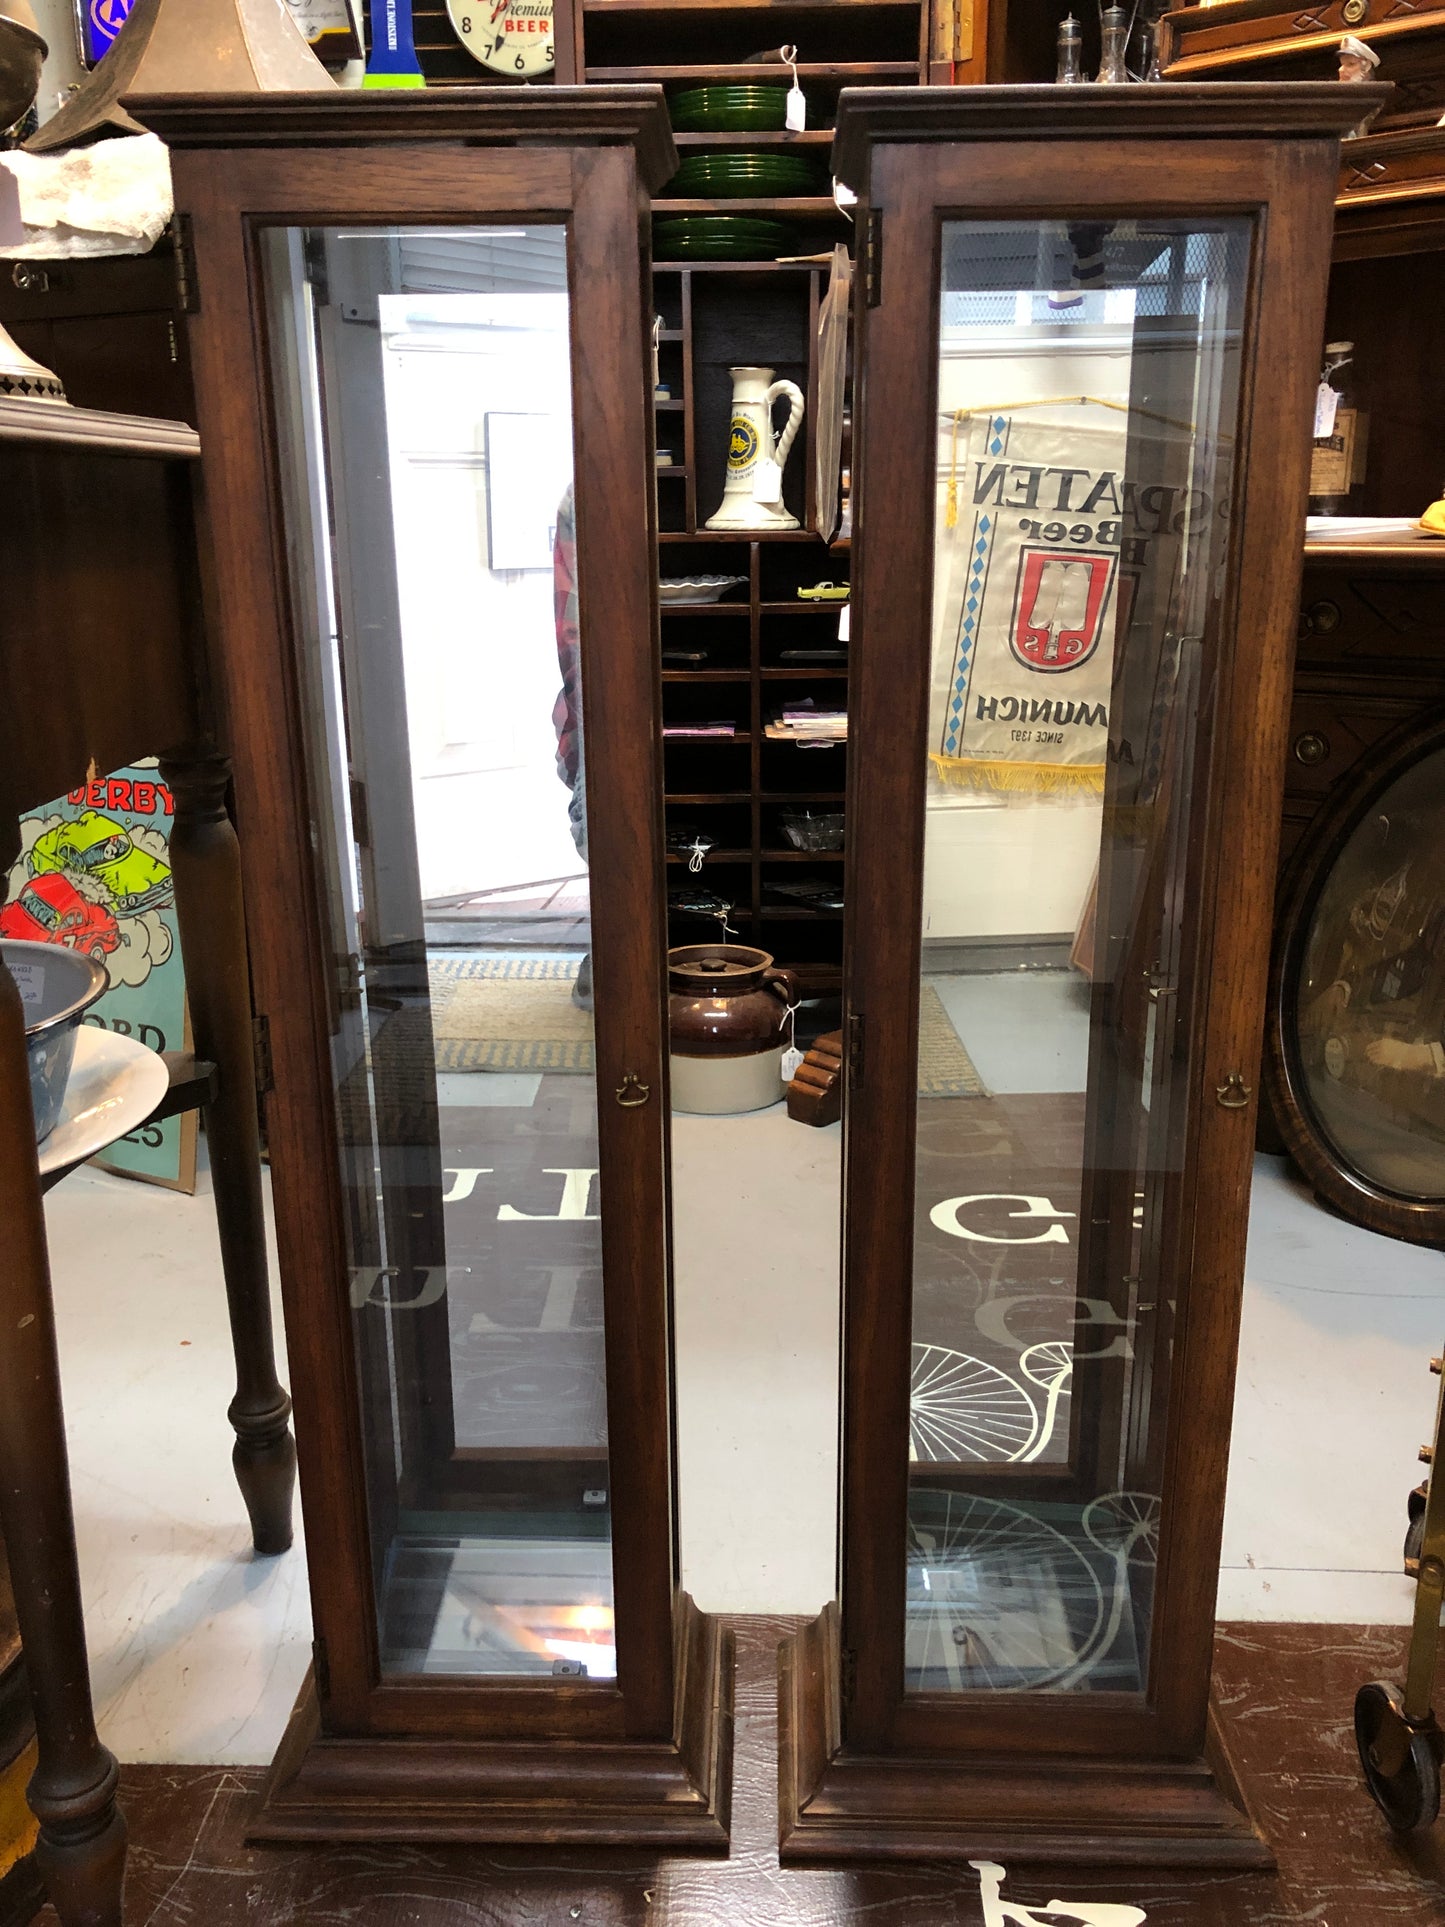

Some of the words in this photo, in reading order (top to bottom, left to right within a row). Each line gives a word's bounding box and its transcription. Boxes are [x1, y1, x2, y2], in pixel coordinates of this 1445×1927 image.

[461, 16, 472, 34] 8
[504, 20, 549, 33] BEER
[483, 44, 493, 60] 7
[545, 45, 555, 62] 5
[514, 53, 525, 70] 6
